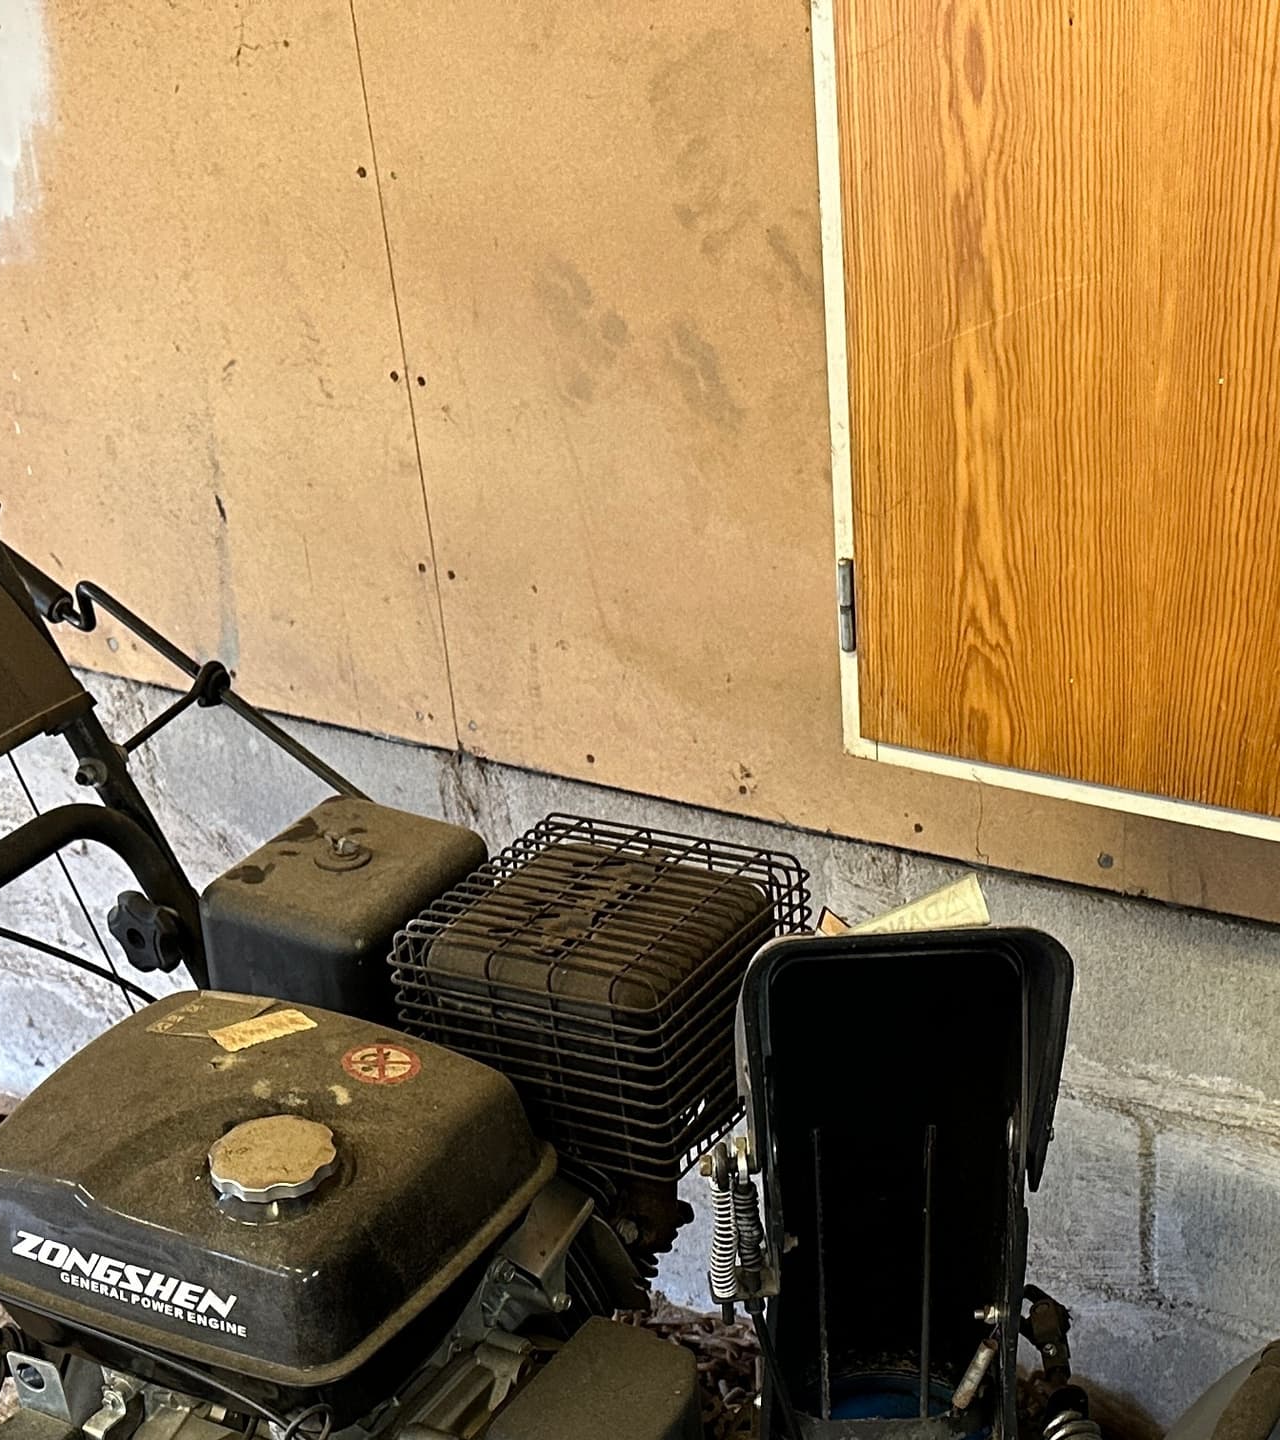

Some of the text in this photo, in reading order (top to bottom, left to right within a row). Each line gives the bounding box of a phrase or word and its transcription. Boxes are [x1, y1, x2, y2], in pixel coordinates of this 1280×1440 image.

[12, 1230, 238, 1318] ZONGSHEN
[60, 1271, 248, 1338] GENERAL POWER ENGINE
